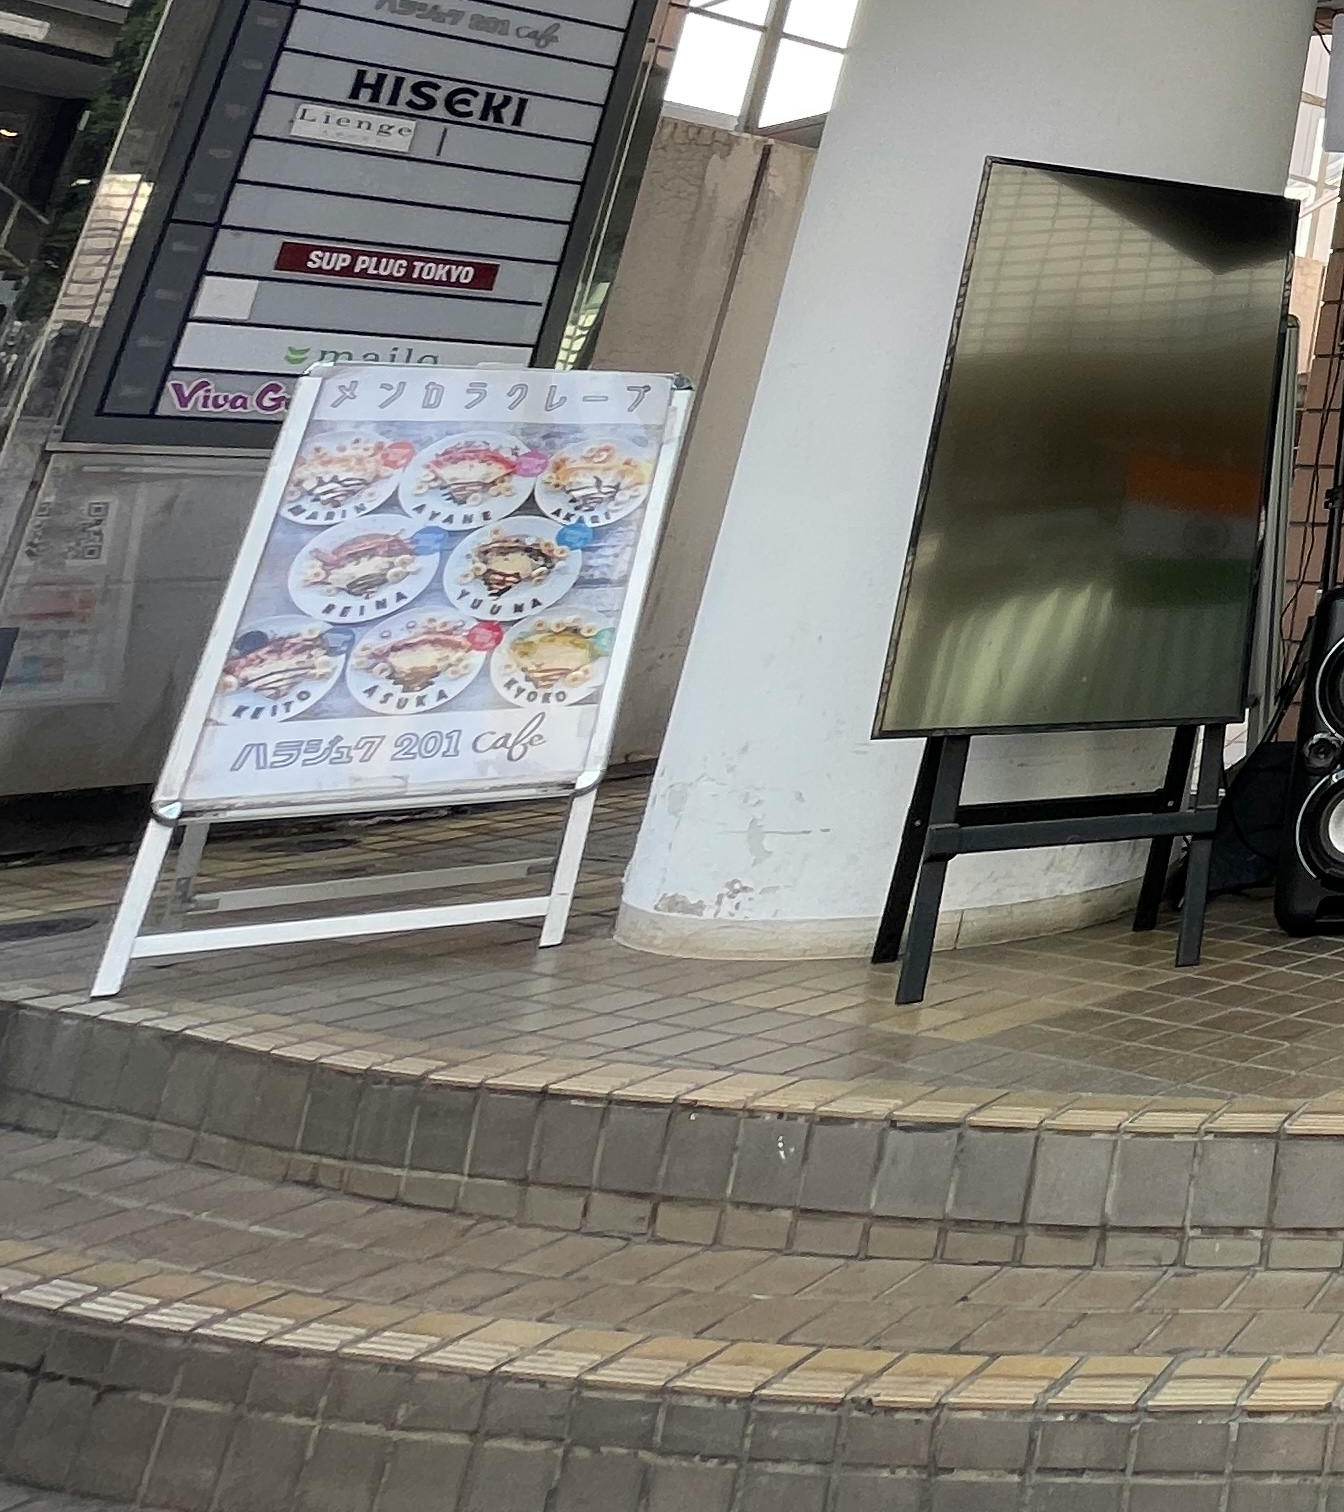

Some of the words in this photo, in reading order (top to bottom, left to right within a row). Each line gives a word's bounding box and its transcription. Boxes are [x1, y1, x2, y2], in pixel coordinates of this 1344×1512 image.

[348, 68, 529, 127] HISEKI
[299, 108, 413, 137] Lienge
[307, 250, 352, 271] SUP
[354, 256, 408, 278] PLUG
[412, 261, 475, 284] TOKYO
[255, 382, 290, 412] G
[391, 729, 463, 762] 201
